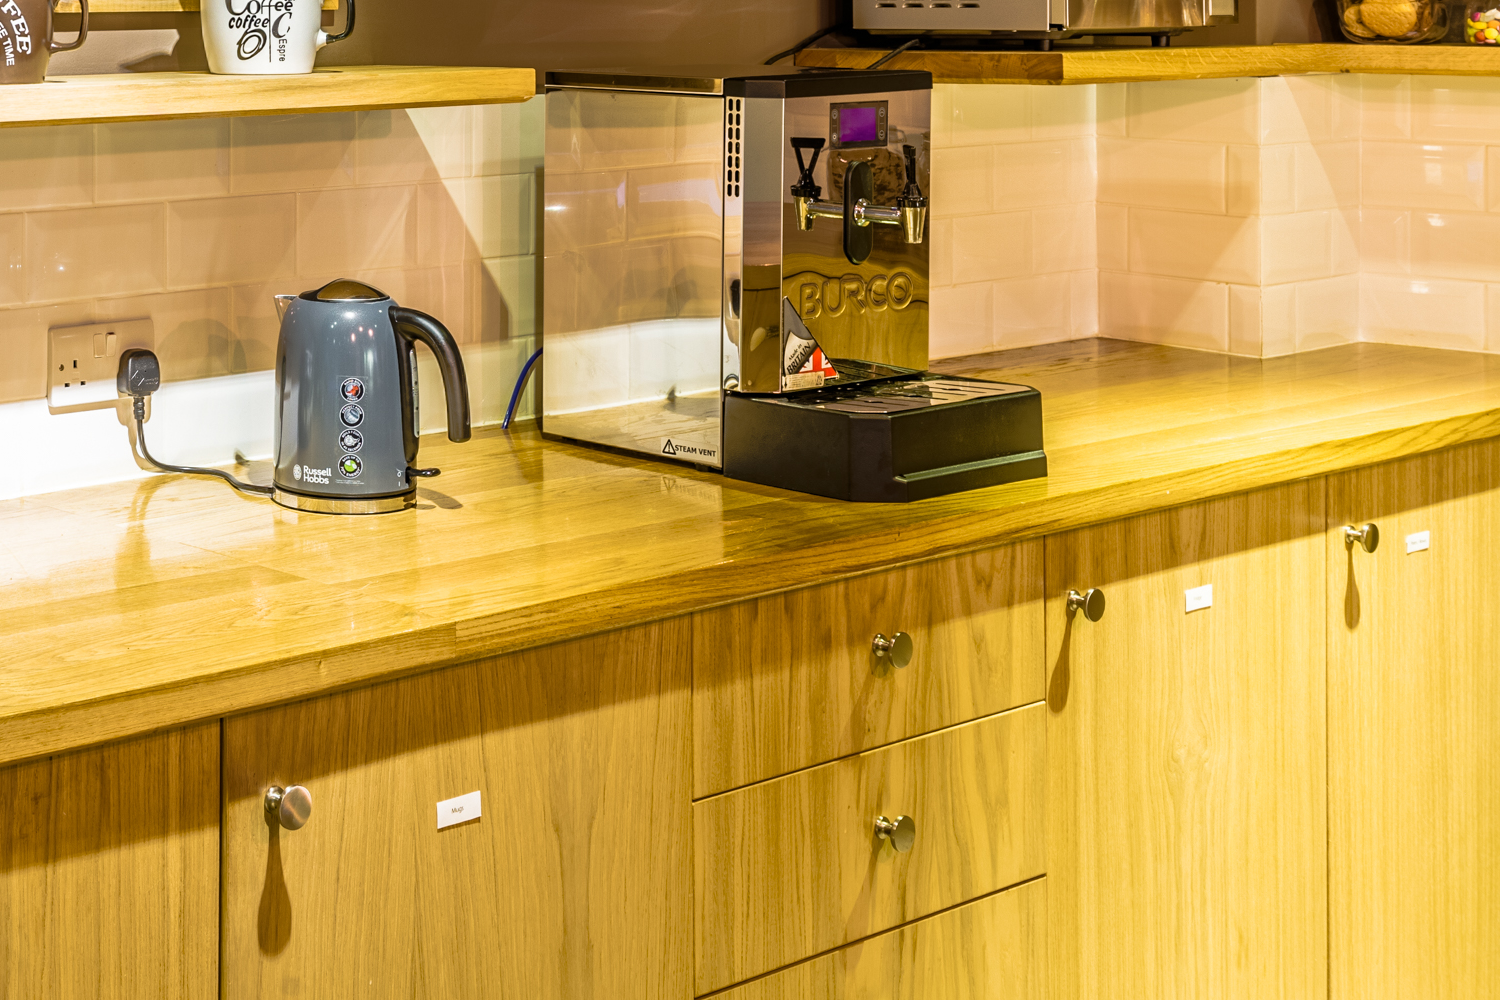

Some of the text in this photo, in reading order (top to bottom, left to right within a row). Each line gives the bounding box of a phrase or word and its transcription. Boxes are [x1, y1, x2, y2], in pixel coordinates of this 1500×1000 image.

[228, 14, 270, 29] coffee
[2, 37, 15, 67] TIME
[276, 38, 288, 62] Espre
[800, 271, 914, 321] BURCO
[786, 341, 812, 375] BRITAIN
[788, 347, 798, 361] Made
[674, 444, 716, 457] STEAM VENT
[303, 465, 332, 477] Russell
[303, 473, 330, 484] Hobbs
